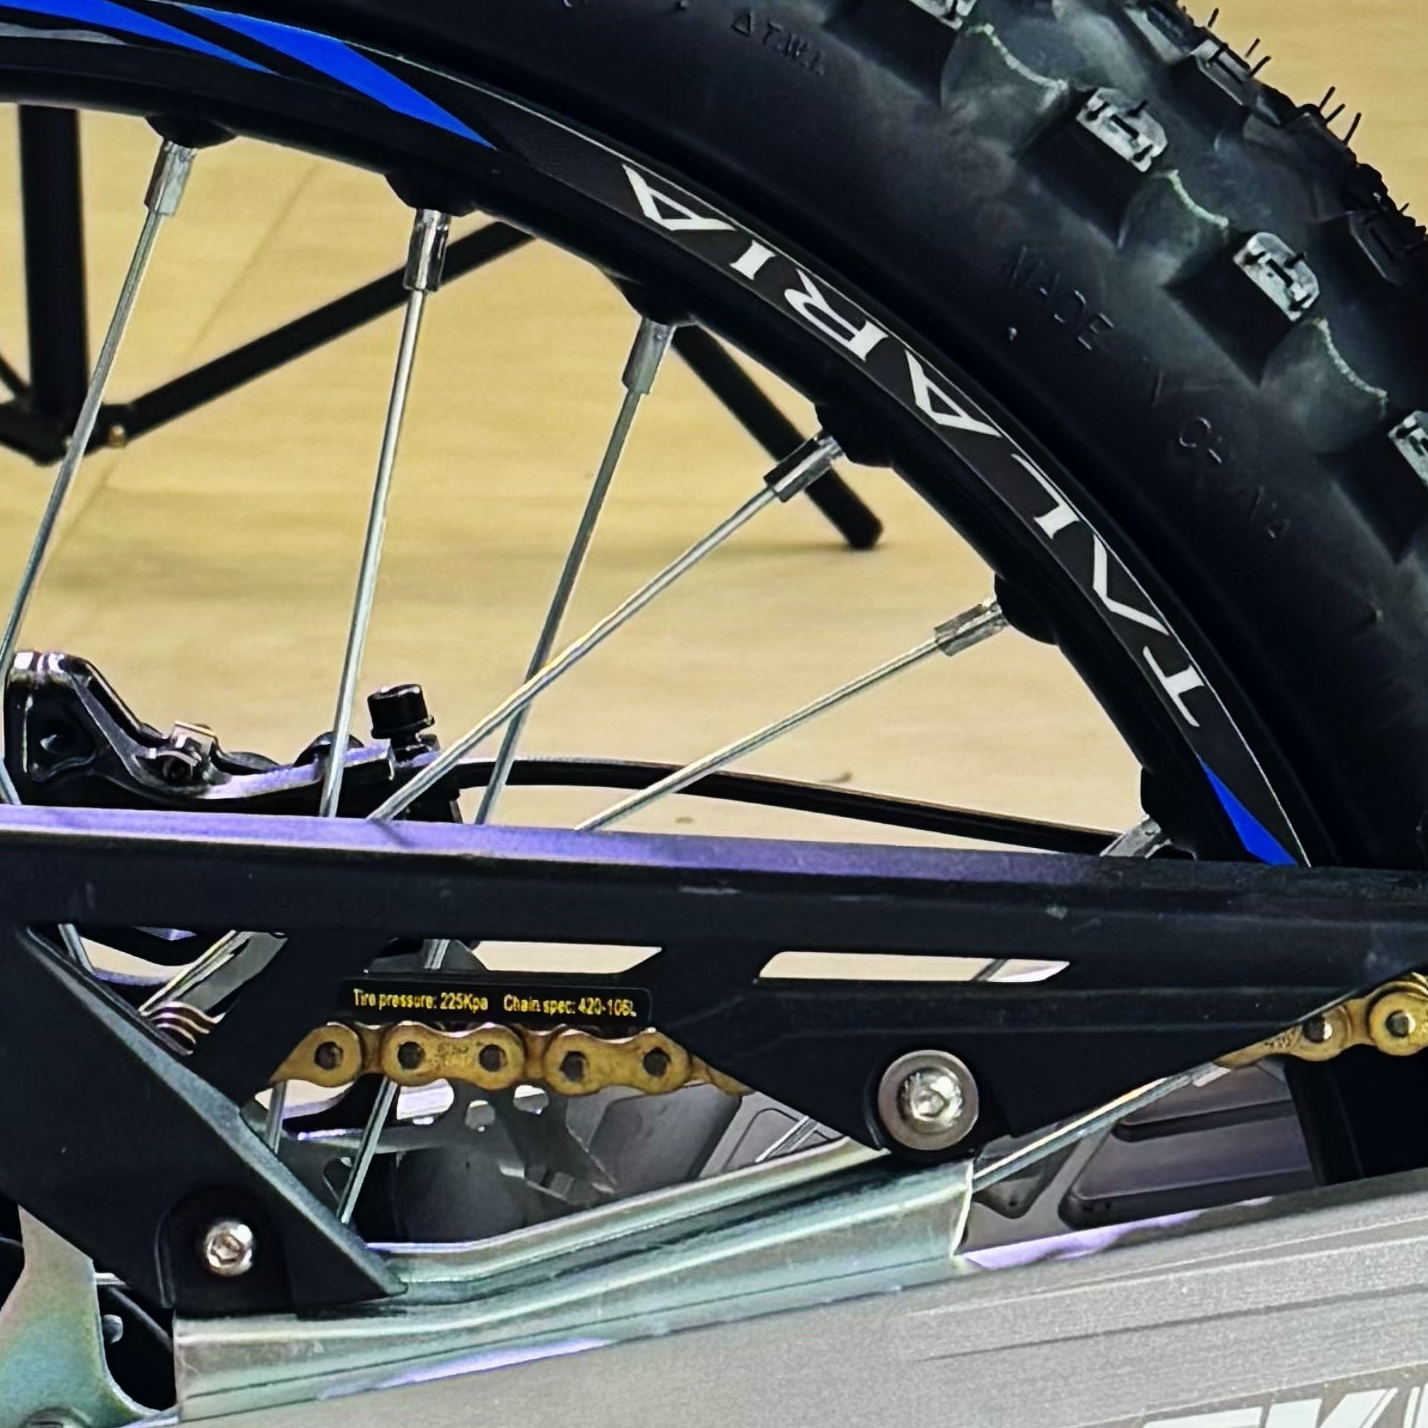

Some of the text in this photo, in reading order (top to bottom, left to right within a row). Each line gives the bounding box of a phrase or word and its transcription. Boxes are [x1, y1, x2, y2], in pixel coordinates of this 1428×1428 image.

[622, 164, 1205, 729] TALARIA
[353, 988, 377, 1007] Tire
[378, 993, 437, 1011] pressure:
[439, 991, 489, 1014] 225Kpa
[503, 994, 541, 1012] Chain
[542, 999, 576, 1016] spec:
